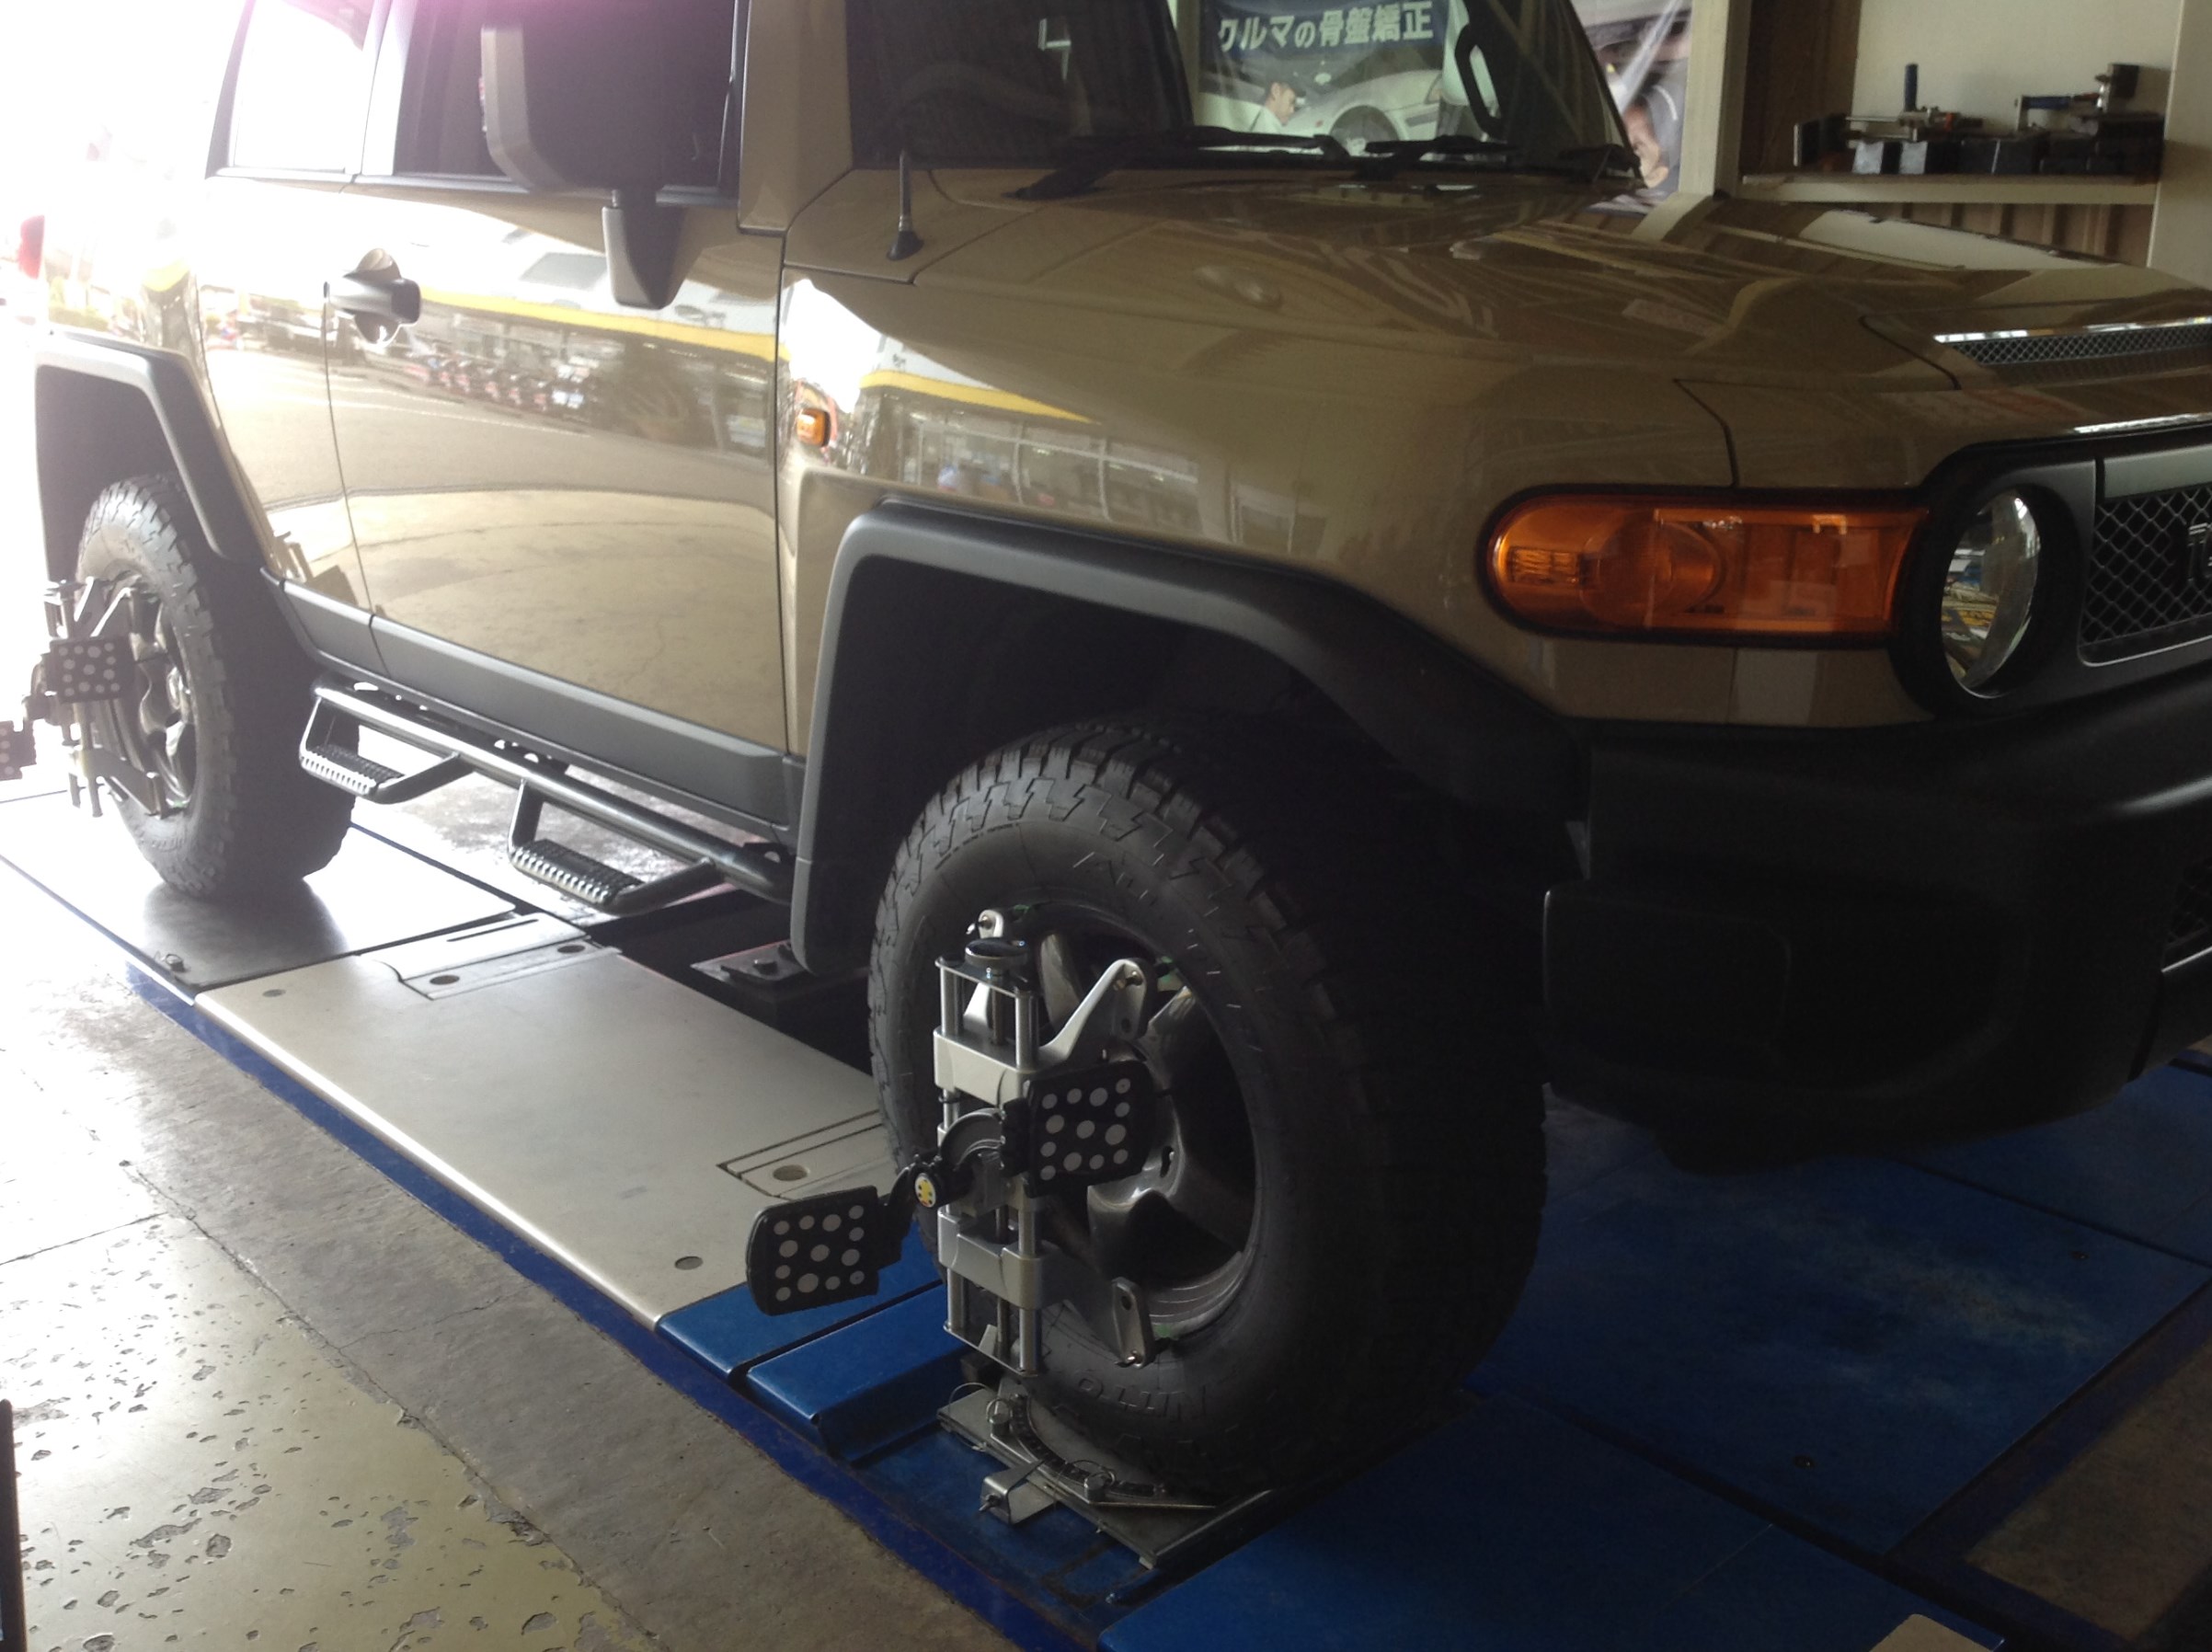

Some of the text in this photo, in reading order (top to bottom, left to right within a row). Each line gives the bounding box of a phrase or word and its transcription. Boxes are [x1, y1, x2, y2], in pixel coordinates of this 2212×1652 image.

[1217, 1, 1435, 52] クルマの骨盤矯正
